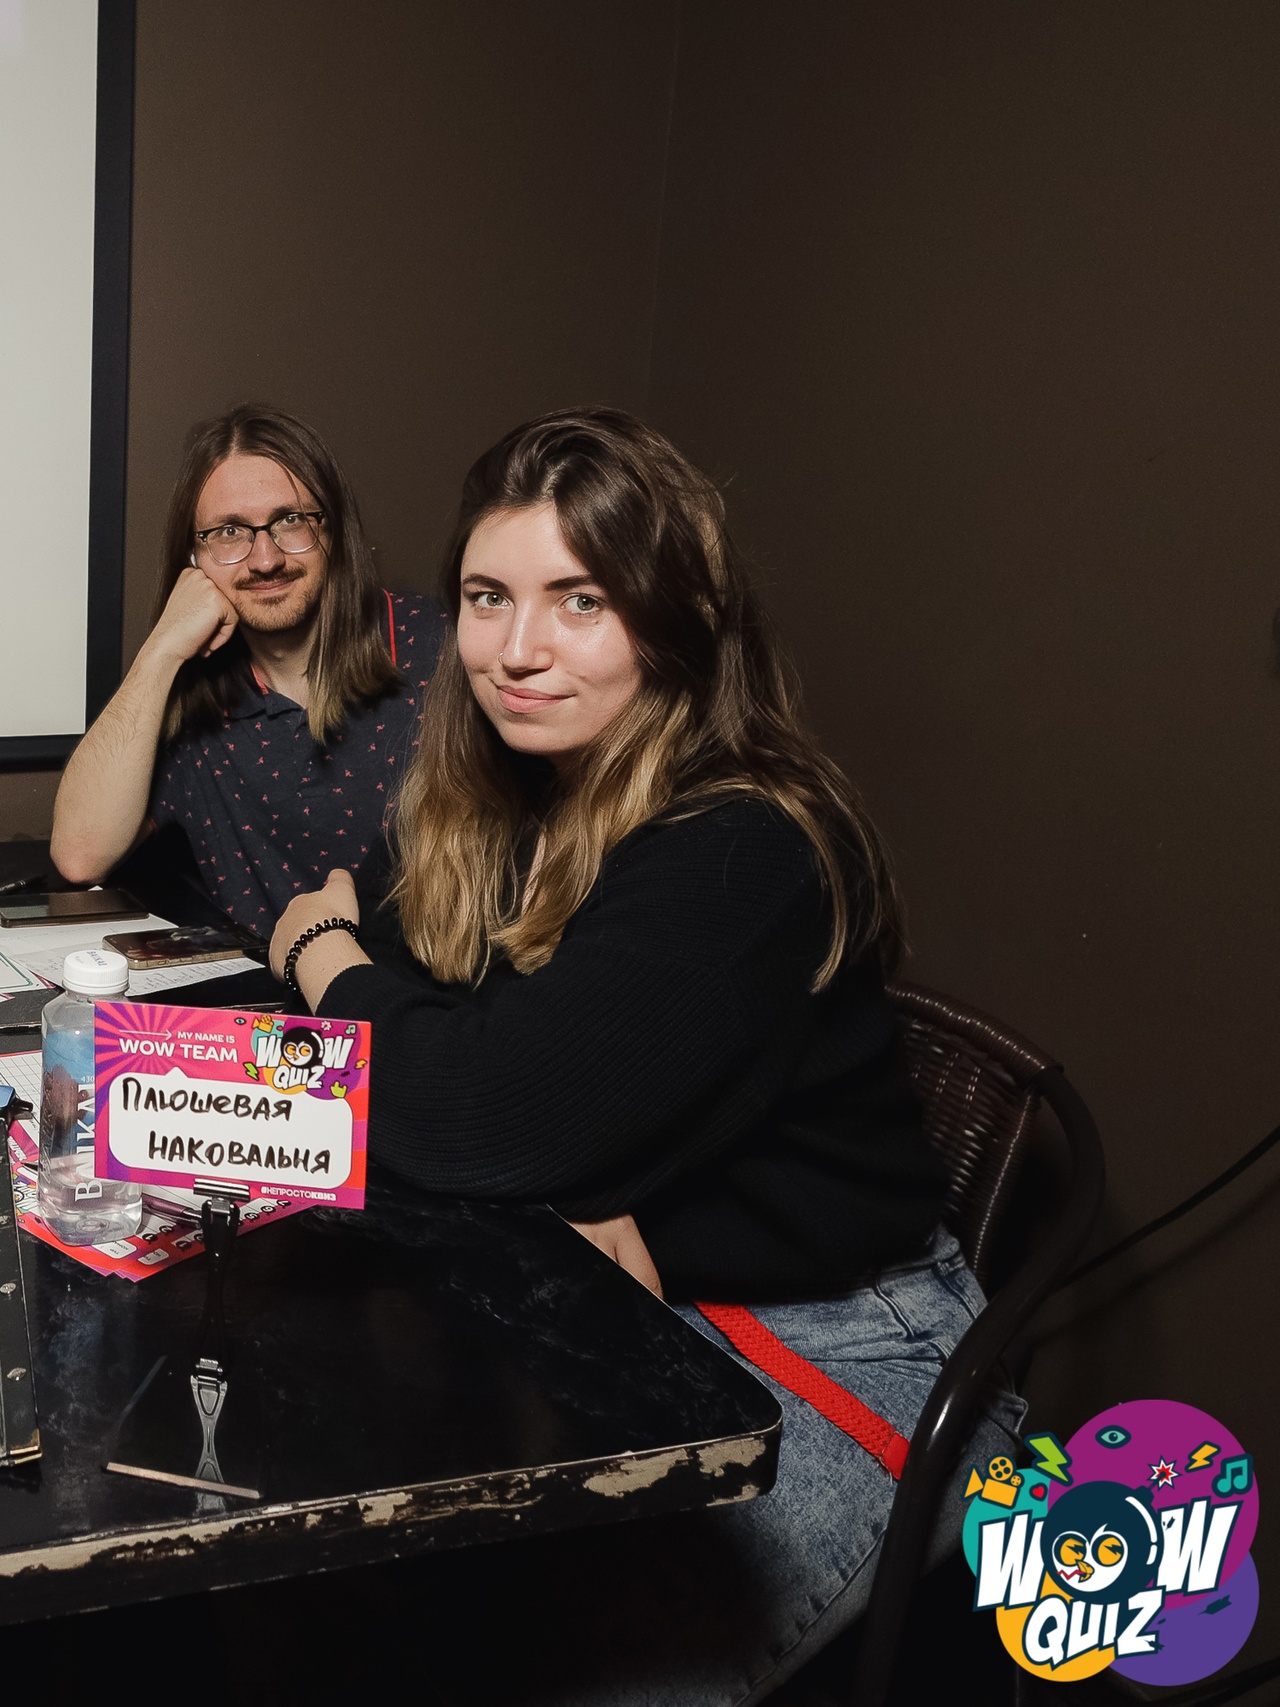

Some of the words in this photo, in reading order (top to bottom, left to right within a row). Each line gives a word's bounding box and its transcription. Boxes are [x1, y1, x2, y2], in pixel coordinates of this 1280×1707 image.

[119, 1038, 175, 1058] WOW
[179, 1044, 238, 1063] TEAM
[177, 1031, 193, 1040] MY
[195, 1032, 224, 1043] NAME
[225, 1034, 235, 1044] IS
[255, 1034, 354, 1070] WOW
[272, 1064, 326, 1090] QUIZ
[148, 1130, 331, 1174] НАКОВАЛЬНЯ
